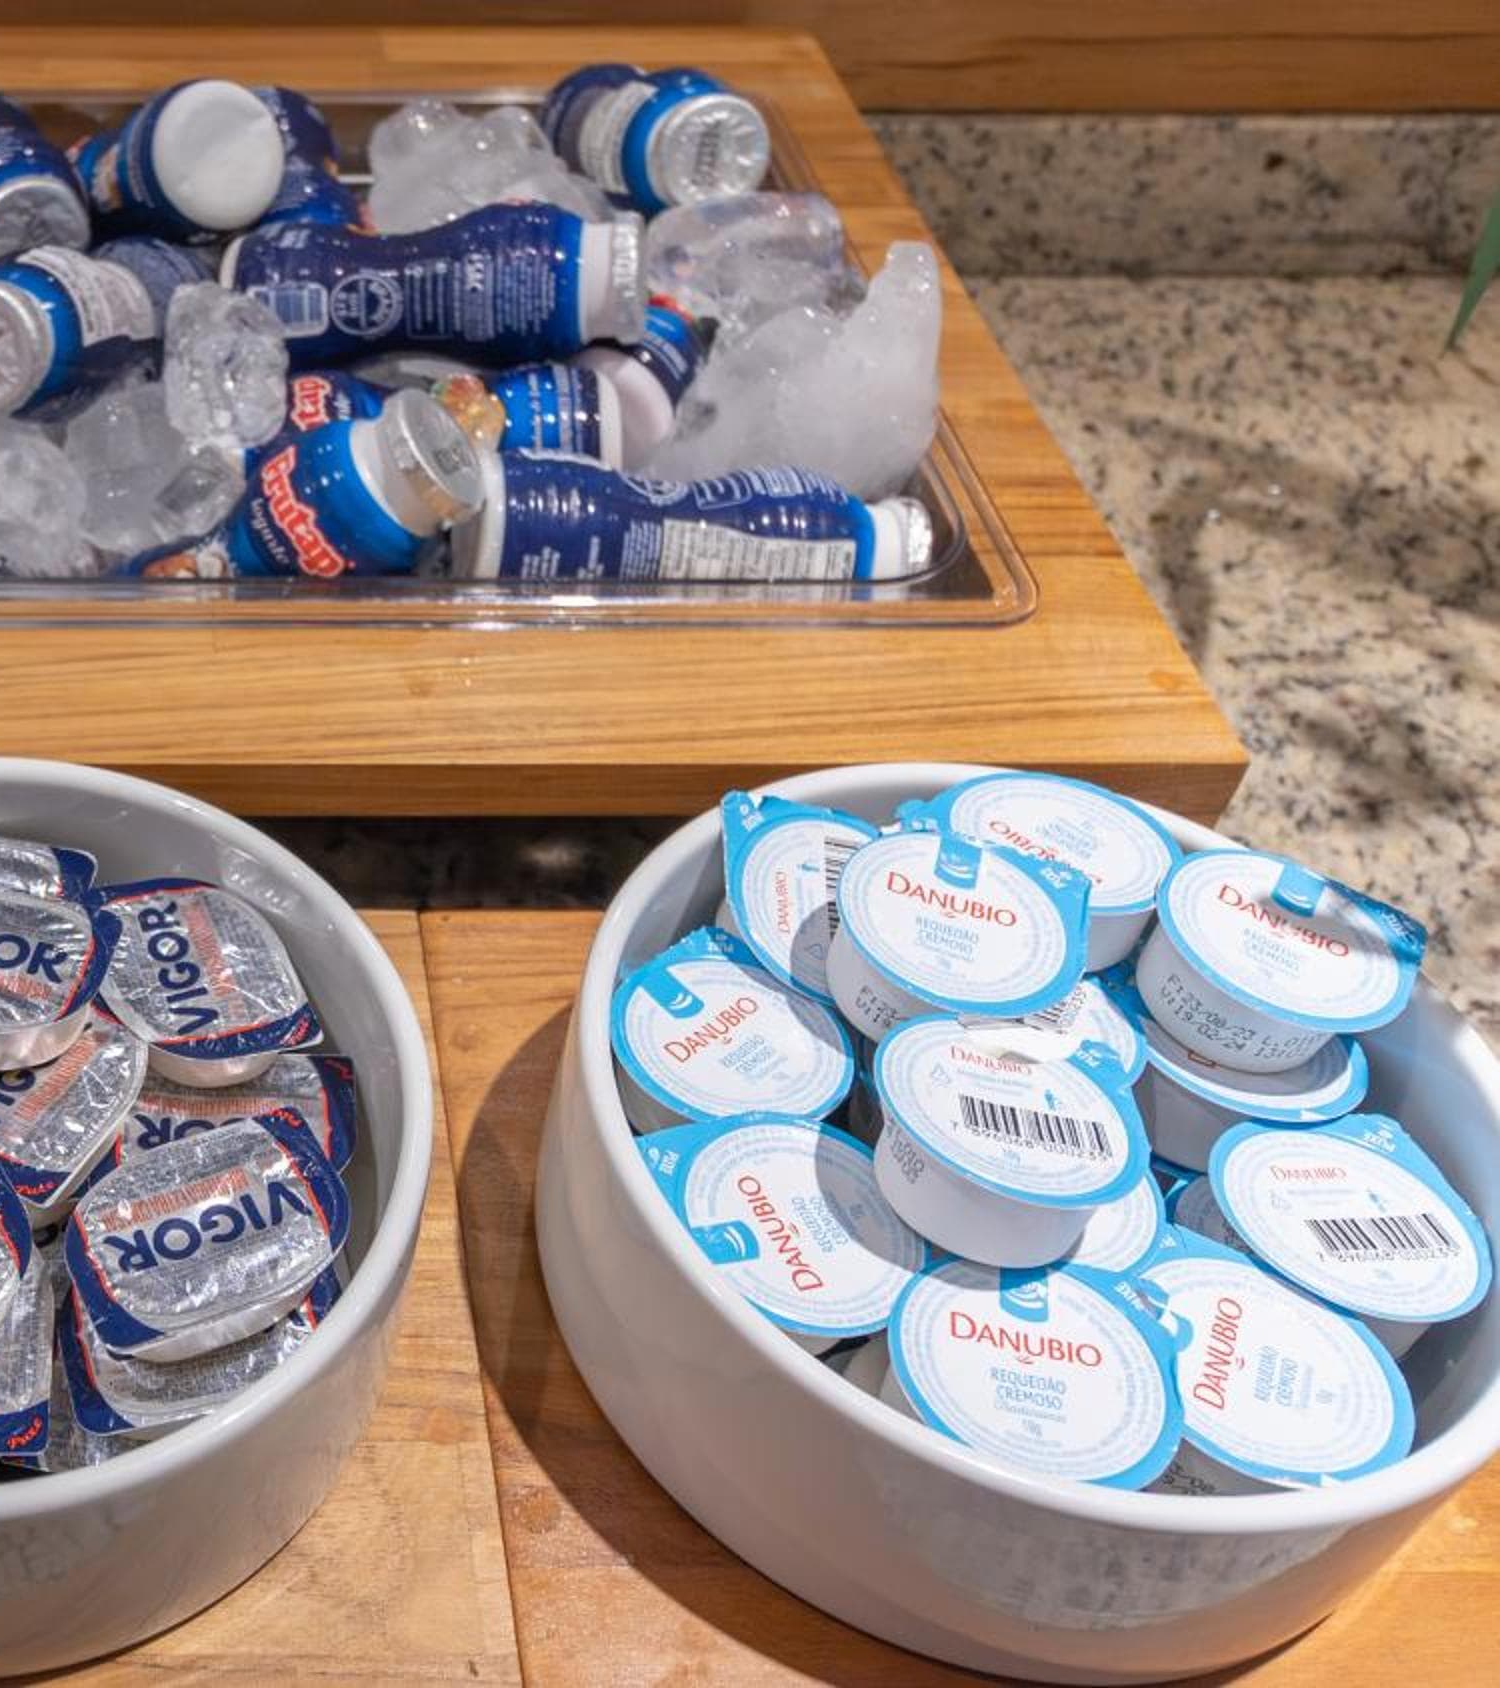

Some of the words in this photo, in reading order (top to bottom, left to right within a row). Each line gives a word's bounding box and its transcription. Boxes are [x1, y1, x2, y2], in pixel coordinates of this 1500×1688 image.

[261, 444, 344, 577] Frutap
[774, 871, 791, 935] DANUBIO
[884, 869, 1019, 929] DANUBIO
[137, 901, 219, 1035] VIGOR
[663, 996, 759, 1064] DANUBIO
[949, 1045, 1034, 1076] DANUBIO
[1269, 1164, 1348, 1182] DANUBIO
[104, 1180, 312, 1274] VIGOR
[736, 1174, 825, 1292] DANUBIO
[949, 1311, 1103, 1368] DANUBIO
[1193, 1297, 1244, 1411] DANUBIO
[995, 1384, 1064, 1411] CREMOSO
